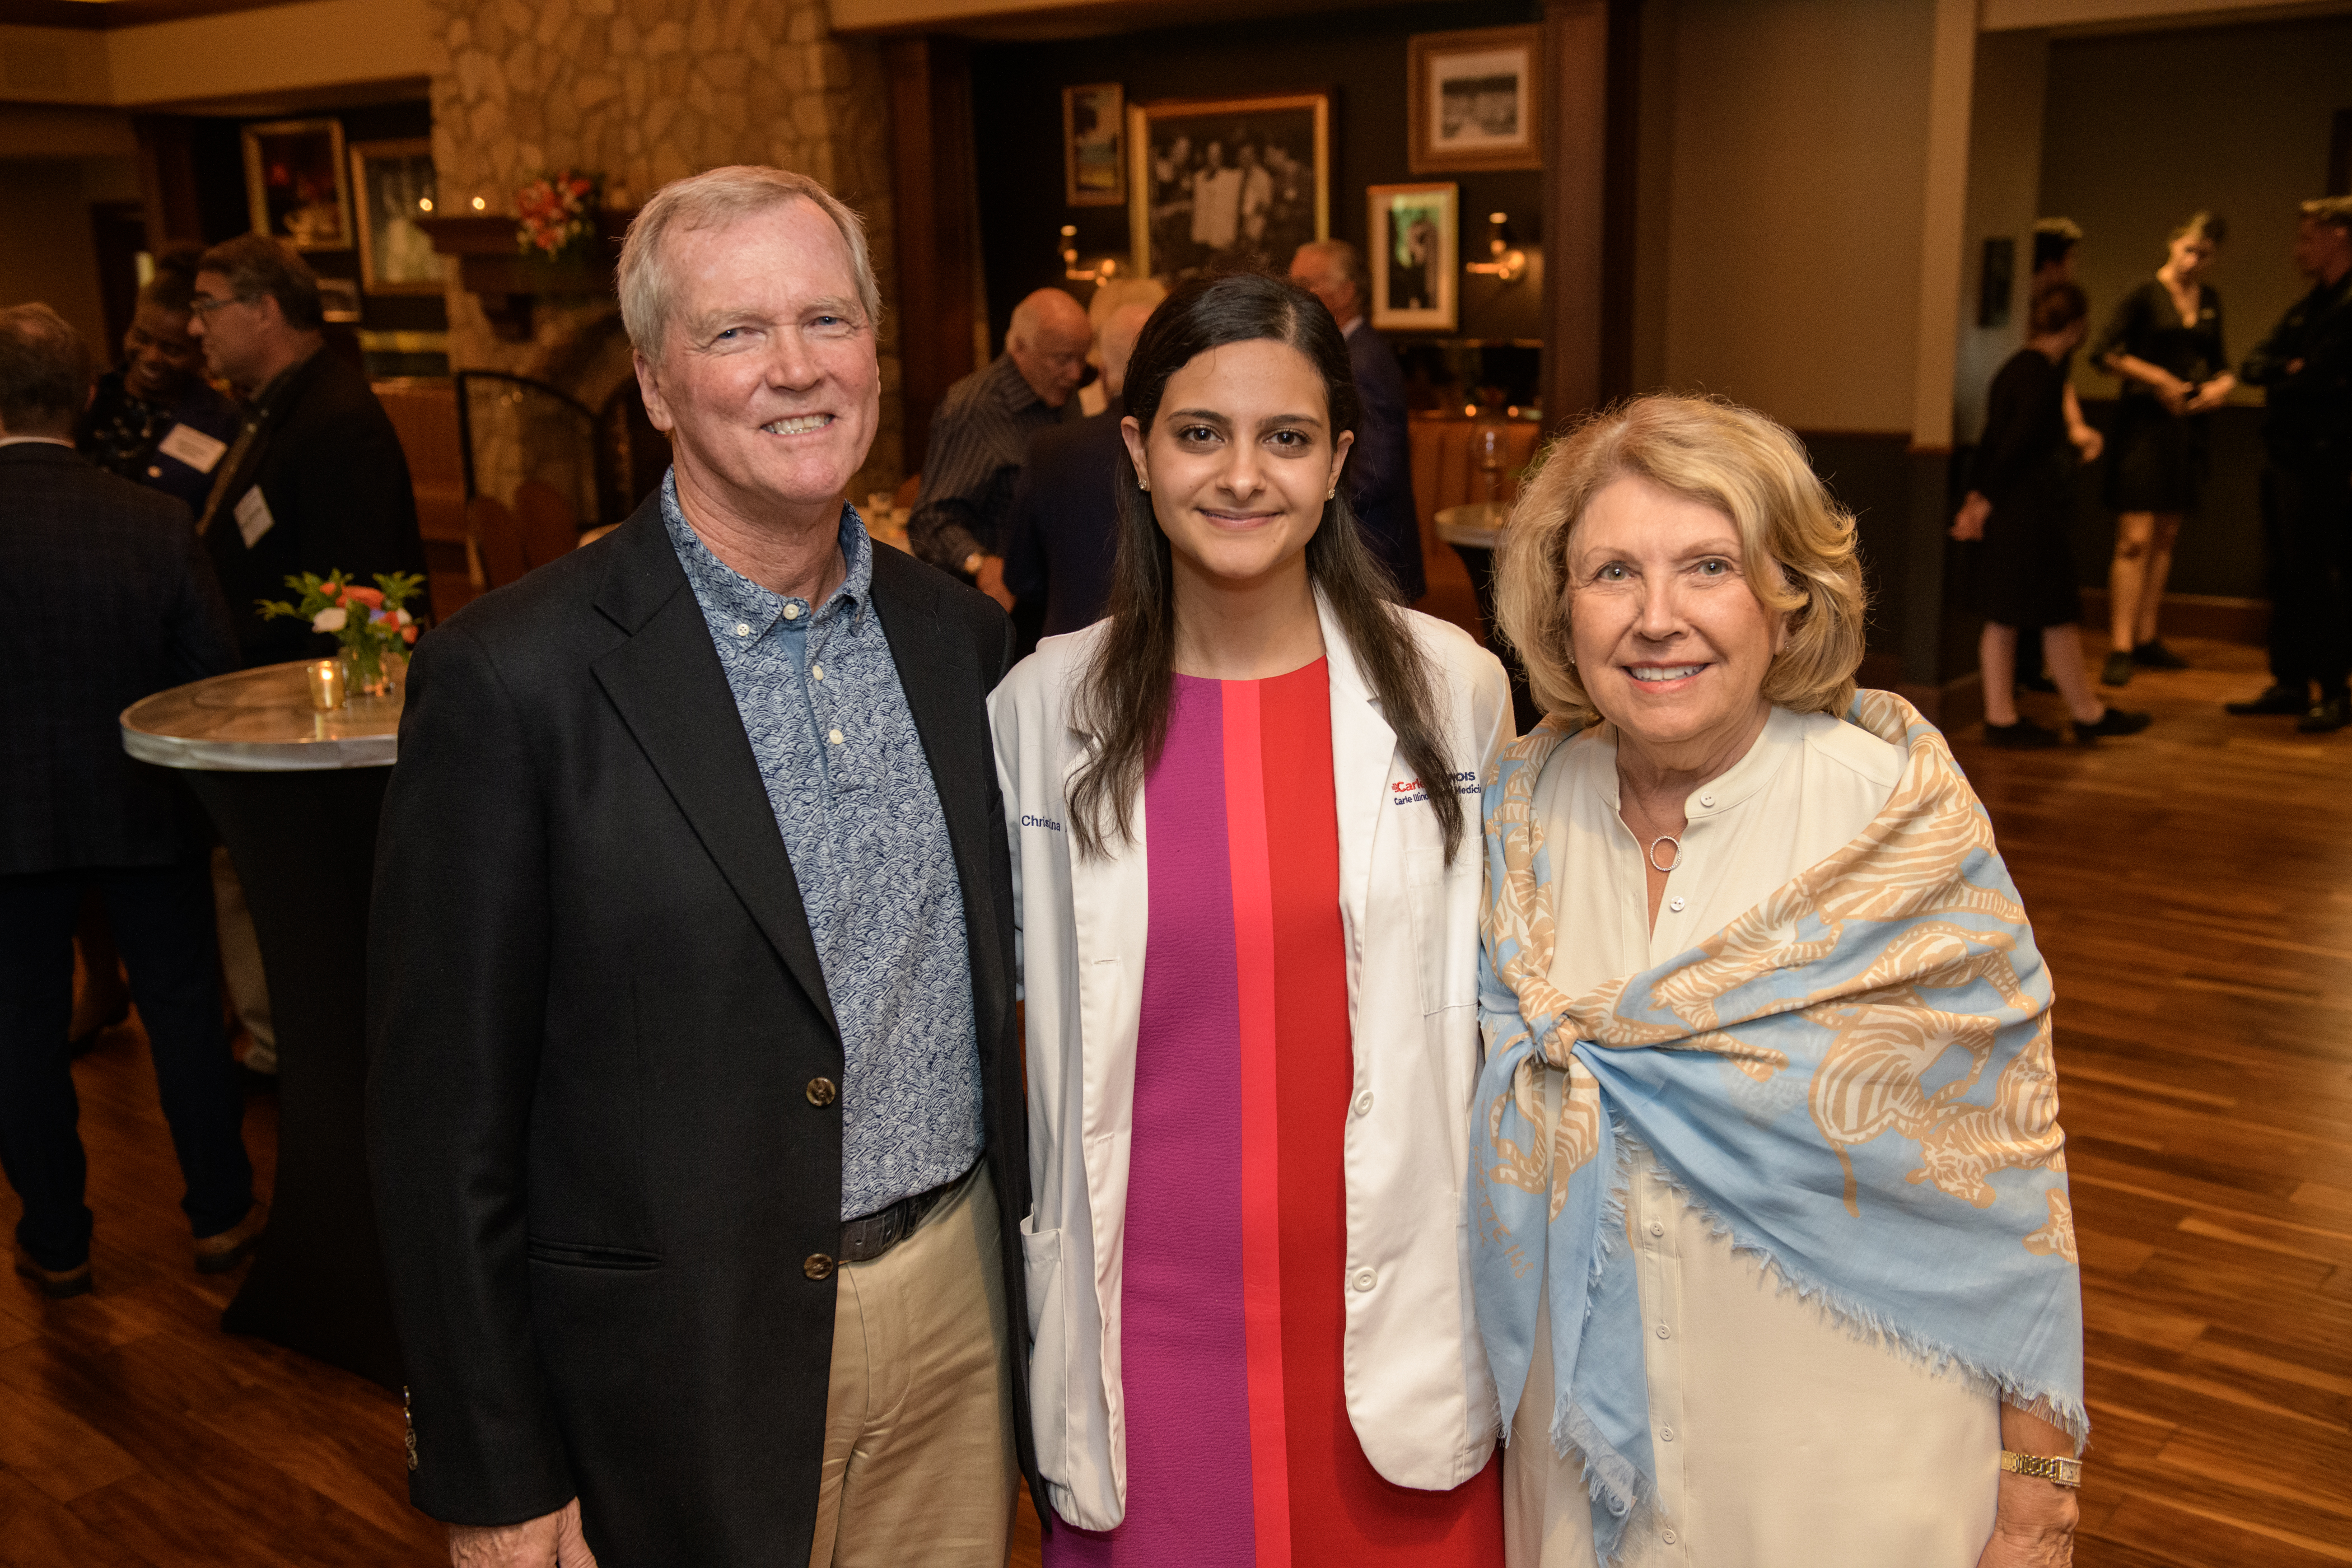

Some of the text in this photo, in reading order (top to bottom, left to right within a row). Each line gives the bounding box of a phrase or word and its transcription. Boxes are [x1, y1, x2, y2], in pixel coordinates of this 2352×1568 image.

[1394, 796, 1412, 805] Carle
[1413, 792, 1429, 802] Illino
[1021, 815, 1061, 832] Christina
